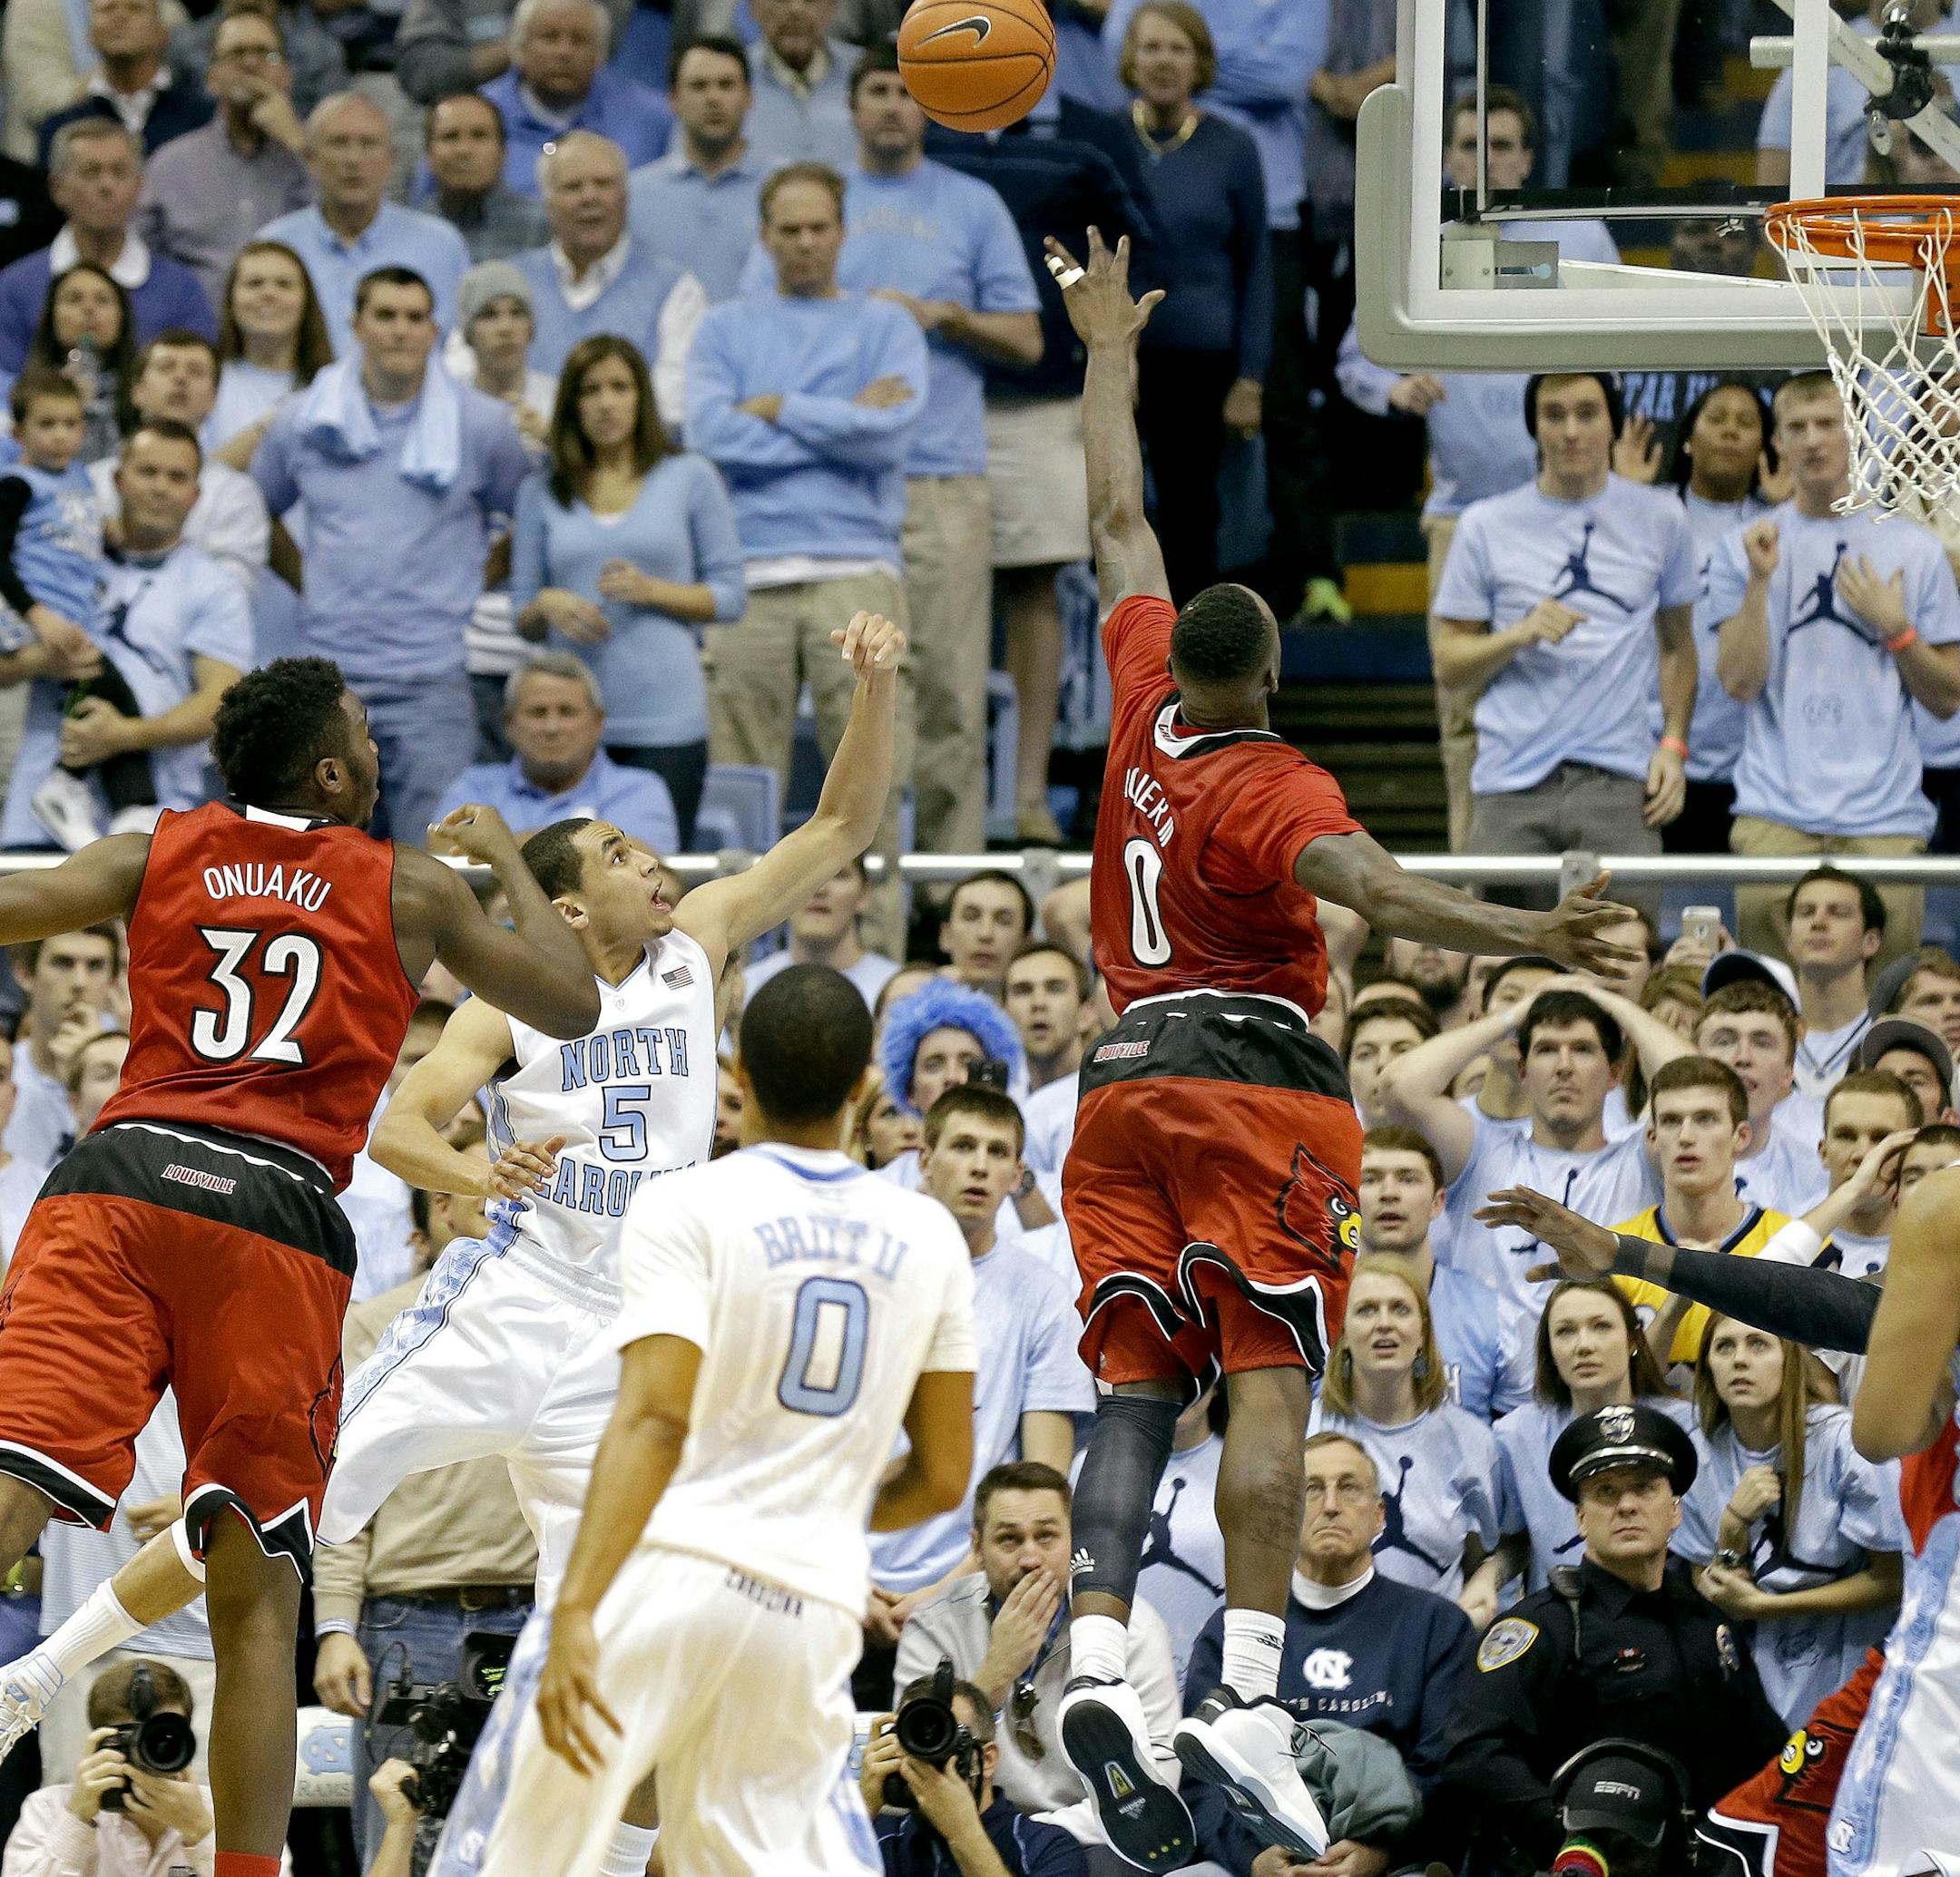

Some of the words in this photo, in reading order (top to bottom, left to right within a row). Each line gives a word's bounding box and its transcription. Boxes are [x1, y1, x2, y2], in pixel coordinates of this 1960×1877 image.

[203, 863, 332, 912] ONUAKU
[1124, 836, 1171, 968] 0
[192, 924, 324, 1063] 32
[561, 1029, 689, 1091] NORTH
[599, 1085, 652, 1162] 5
[161, 1163, 237, 1195] LOUISVILLE
[778, 1276, 870, 1417] 0
[1593, 1780, 1642, 1800] ESPN
